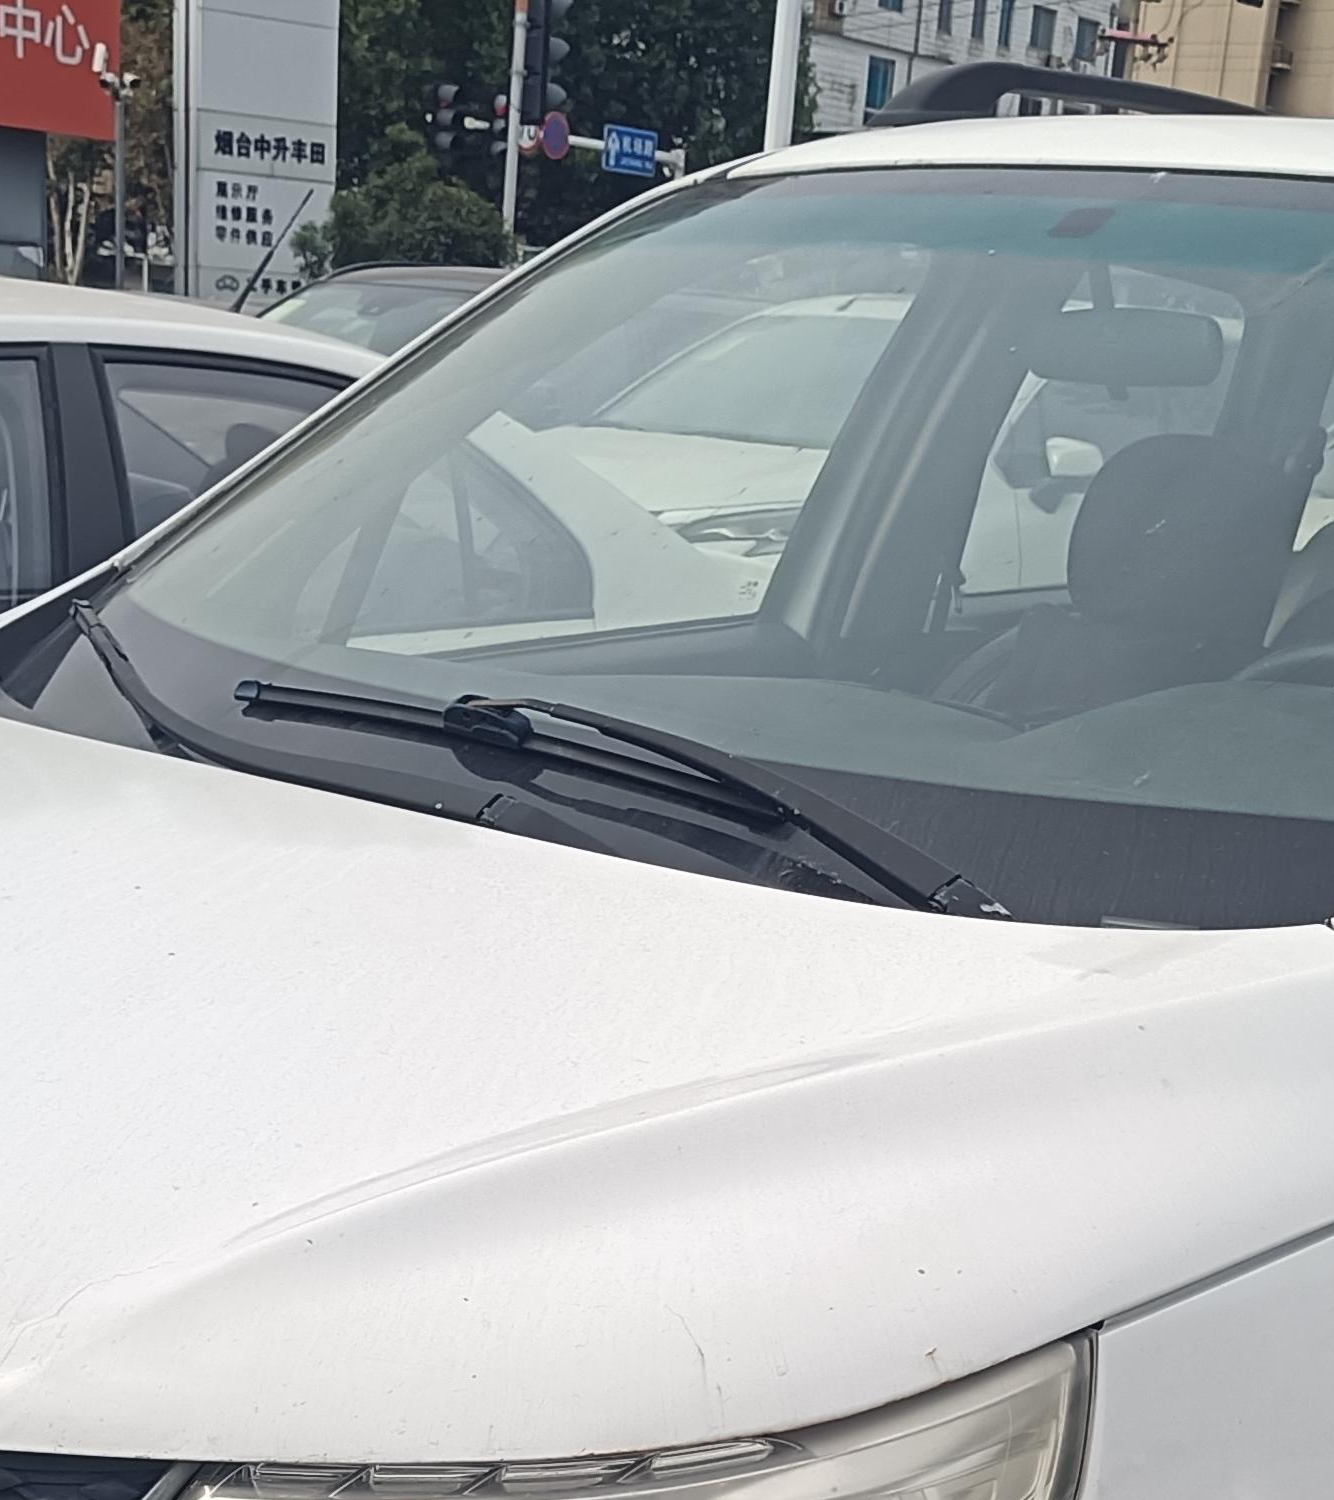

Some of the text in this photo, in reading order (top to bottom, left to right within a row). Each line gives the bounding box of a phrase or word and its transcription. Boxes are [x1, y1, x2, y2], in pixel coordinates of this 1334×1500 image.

[215, 130, 326, 165] 烟台中升丰田
[216, 181, 258, 201] 展示厅
[216, 205, 273, 226] 维修服务
